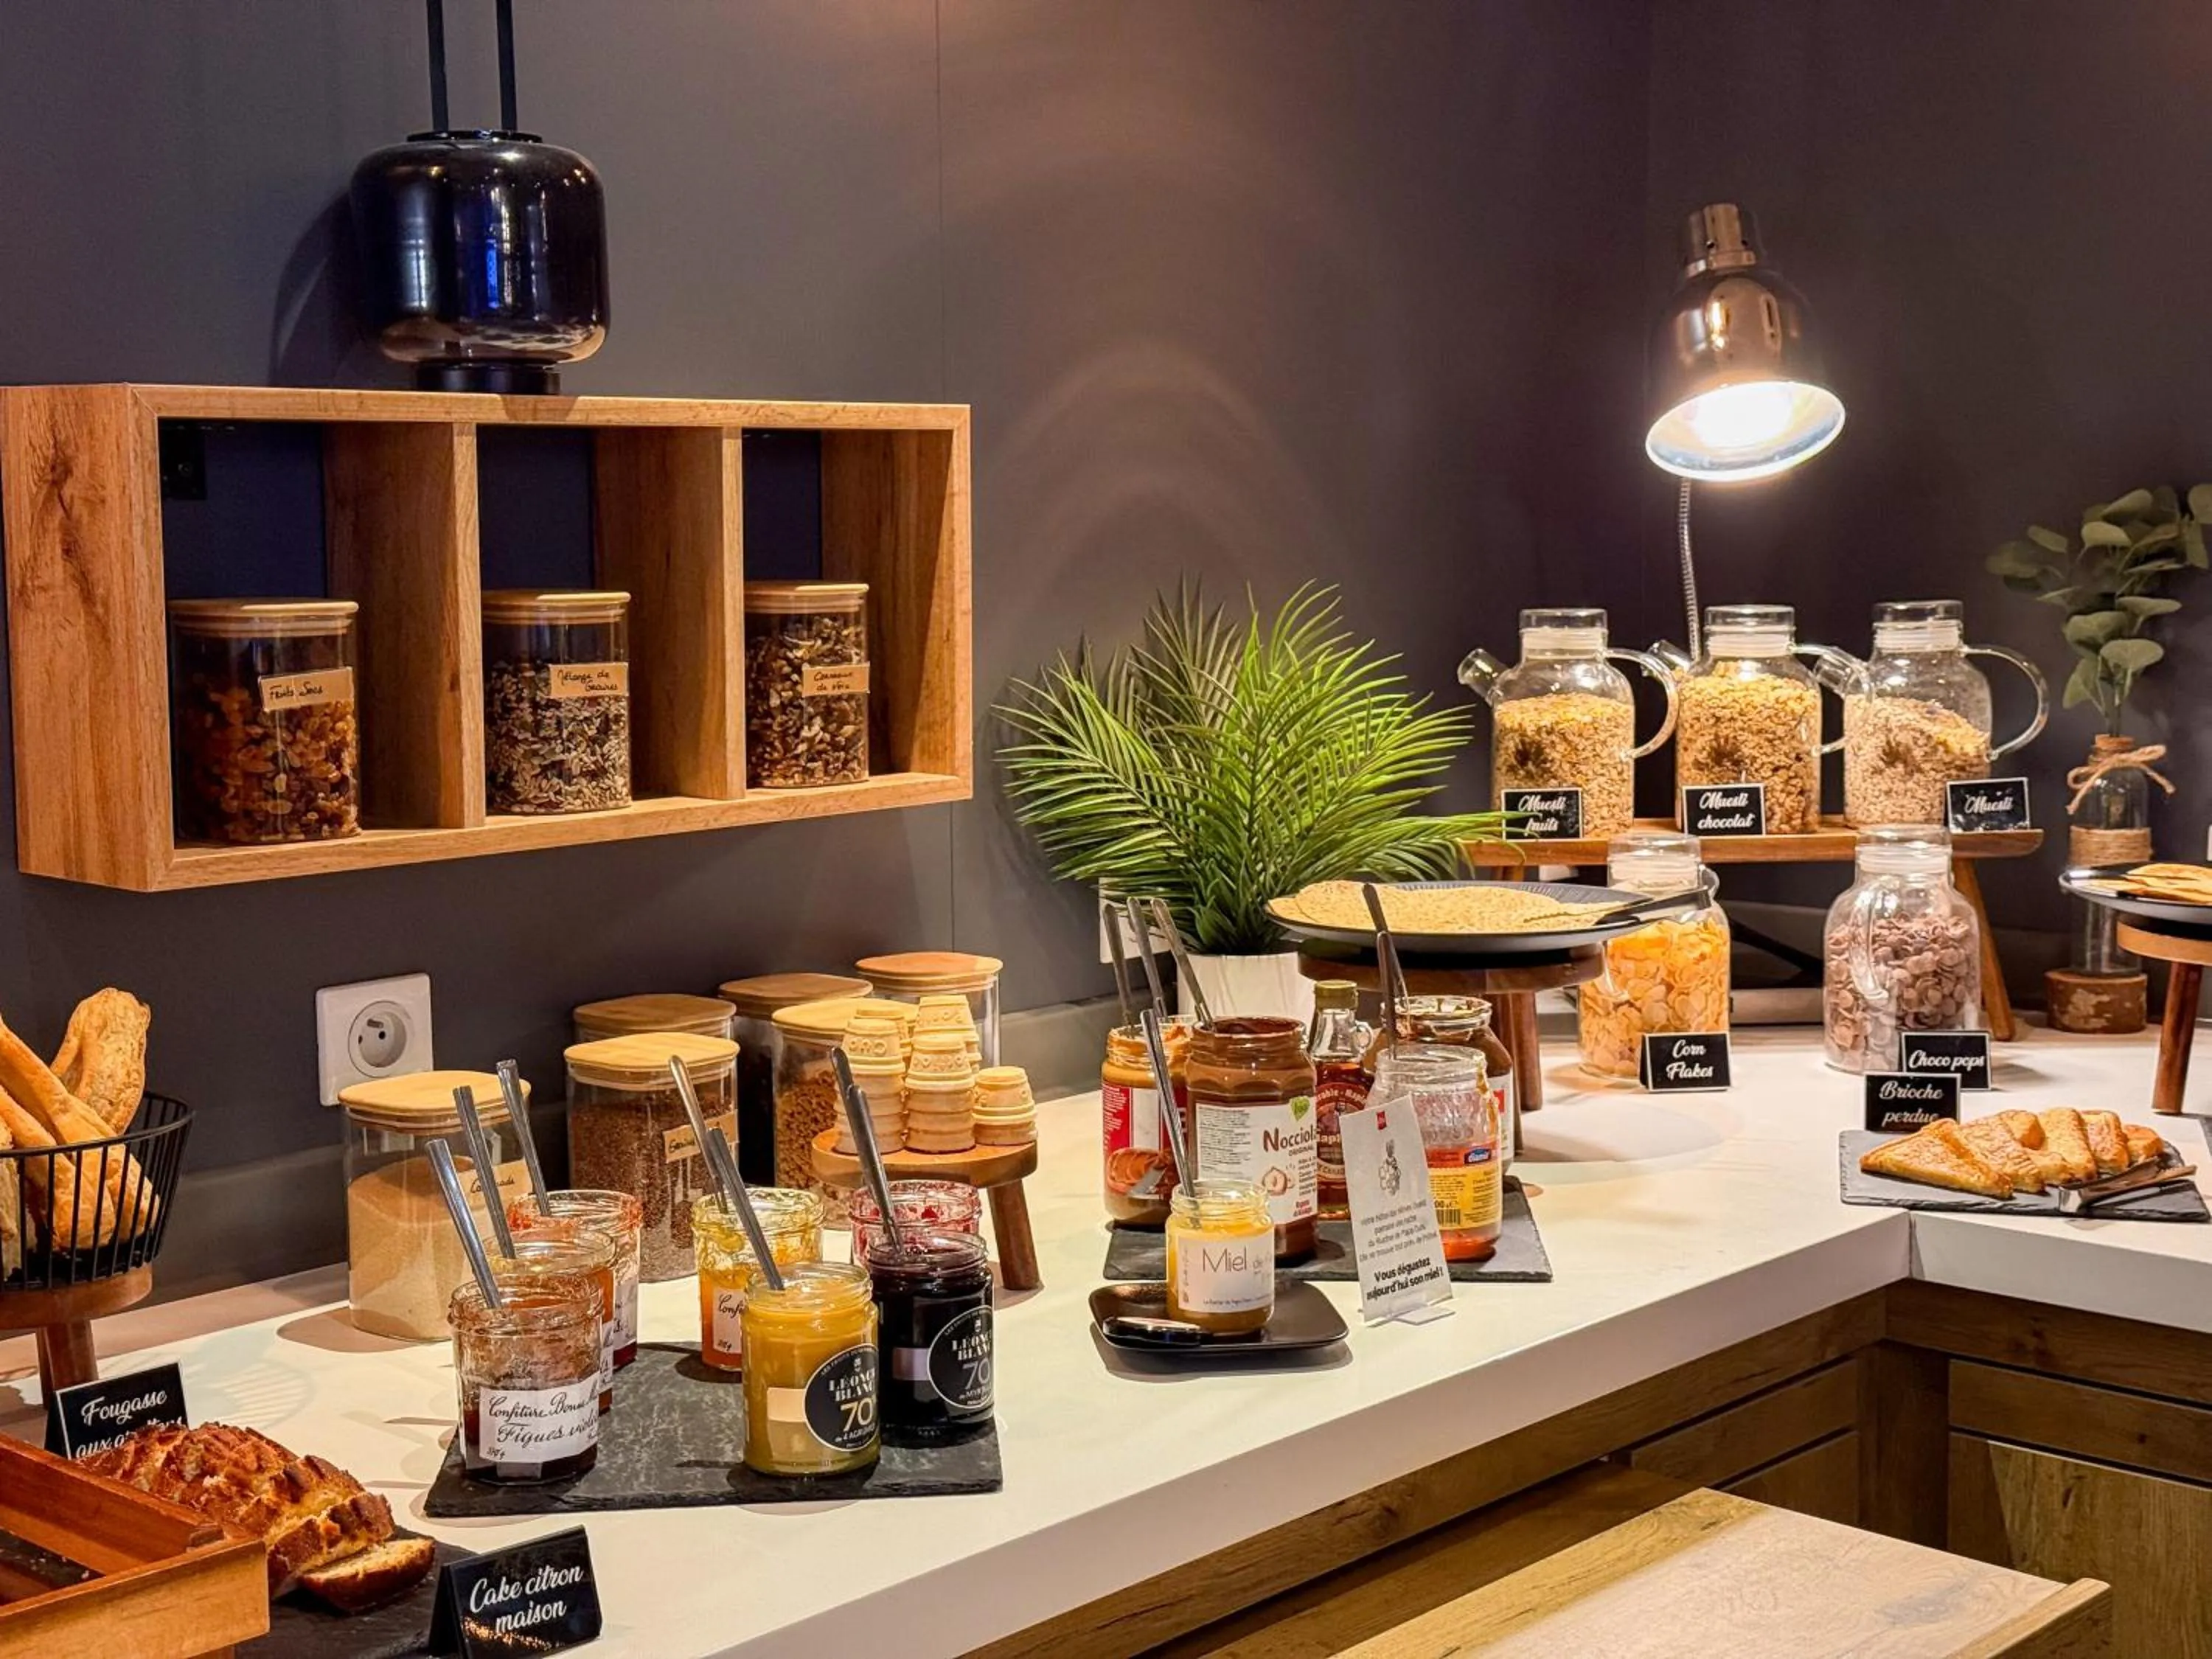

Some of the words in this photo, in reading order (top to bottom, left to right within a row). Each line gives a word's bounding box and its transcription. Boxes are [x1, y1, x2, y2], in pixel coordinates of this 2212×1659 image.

[1519, 796, 1566, 812] Muesli
[1699, 791, 1748, 810] Muesli
[1964, 796, 2014, 814] Muesli
[1525, 816, 1558, 837] fruits
[1697, 813, 1756, 829] chocolat
[1672, 1039, 1706, 1058] Corn
[1666, 1061, 1714, 1081] Flakes
[1908, 1049, 1951, 1068] Choco
[1951, 1055, 1986, 1071] pops
[1879, 1080, 1944, 1100] Brioche
[1882, 1107, 1939, 1127] perdue
[1203, 1245, 1247, 1273] Miel
[1374, 1268, 1397, 1283] Vous
[1397, 1256, 1431, 1276] dégustez
[1366, 1276, 1409, 1301] aujourd'hui
[1409, 1274, 1424, 1287] son
[1425, 1267, 1439, 1281] miel
[962, 1358, 990, 1390] 70
[80, 1390, 167, 1427] Fougasse
[489, 1396, 548, 1422] Confiture
[841, 1397, 873, 1432] 70
[497, 1422, 564, 1448] Figues
[75, 1437, 111, 1458] aux
[470, 1576, 523, 1613] Cake
[524, 1565, 584, 1595] citron
[495, 1599, 567, 1634] maison
